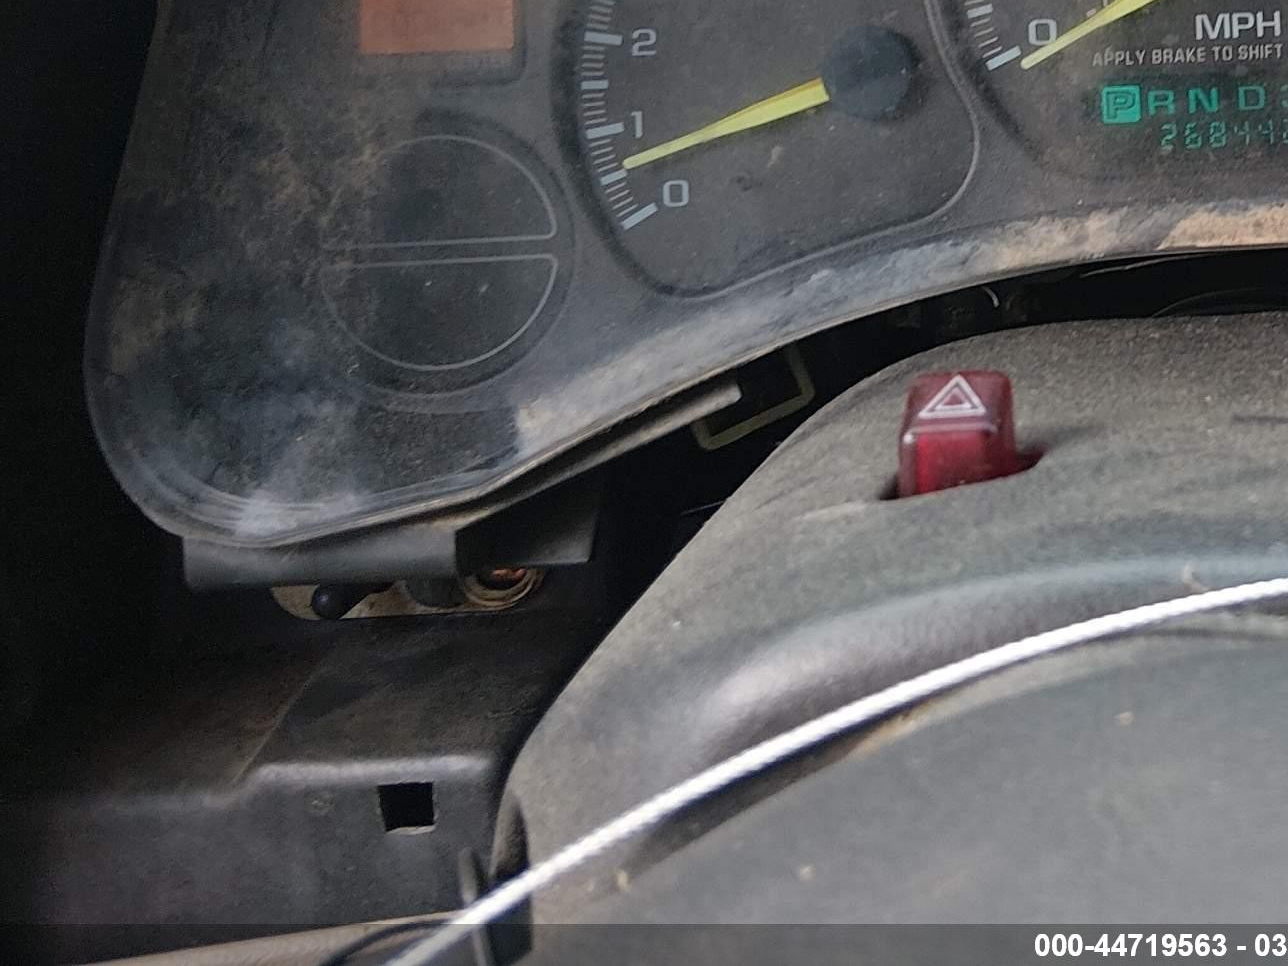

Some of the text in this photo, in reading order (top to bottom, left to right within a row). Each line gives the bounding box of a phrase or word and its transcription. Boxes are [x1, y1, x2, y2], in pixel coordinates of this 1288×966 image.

[1028, 19, 1058, 47] 0
[1195, 10, 1281, 40] MPH
[631, 29, 657, 56] 2
[1092, 47, 1146, 67] APPLY
[1151, 46, 1206, 65] BRAKE
[1211, 45, 1233, 61] TO
[1238, 43, 1283, 60] SHIFT
[1105, 91, 1135, 120] P
[1147, 90, 1175, 115] R
[1188, 87, 1218, 113] N
[1238, 85, 1265, 110] D
[631, 111, 644, 138] 1
[662, 179, 690, 207] 0
